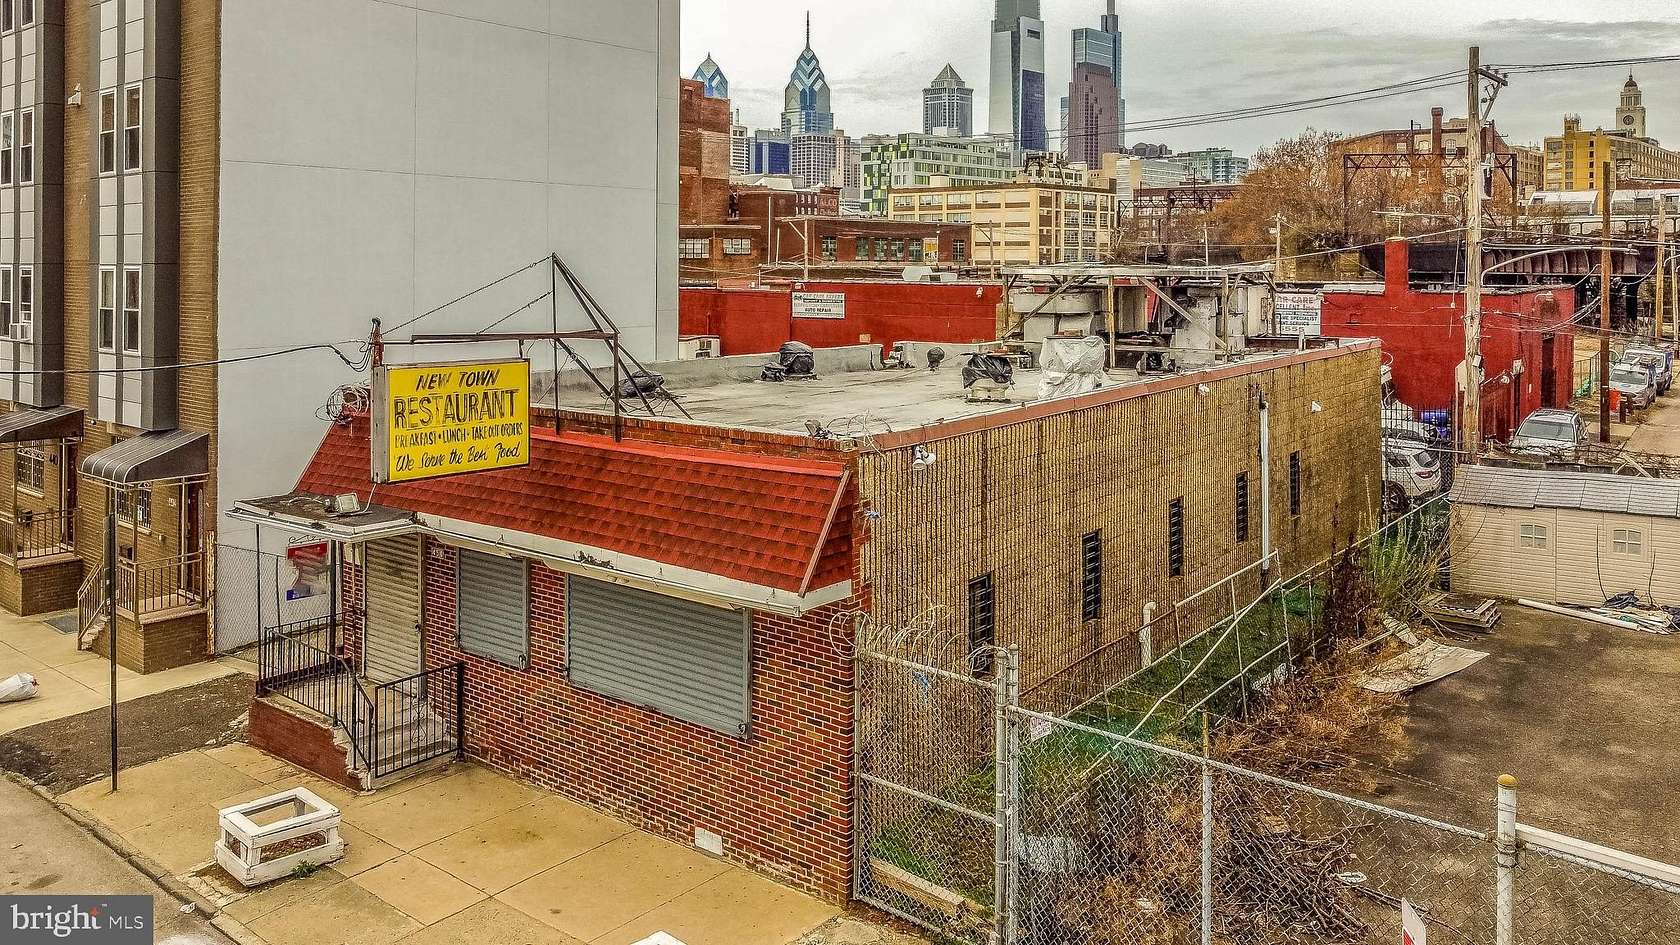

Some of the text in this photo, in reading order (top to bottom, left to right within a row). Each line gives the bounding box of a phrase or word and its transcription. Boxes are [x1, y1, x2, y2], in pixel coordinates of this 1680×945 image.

[1276, 296, 1315, 305] AR-CARE
[416, 368, 500, 391] NEW TOWN
[394, 389, 520, 429] RESTAURANT
[471, 425, 488, 441] TAKE
[501, 422, 523, 436] ORDERS
[395, 441, 520, 472] We Serve the Best Food
